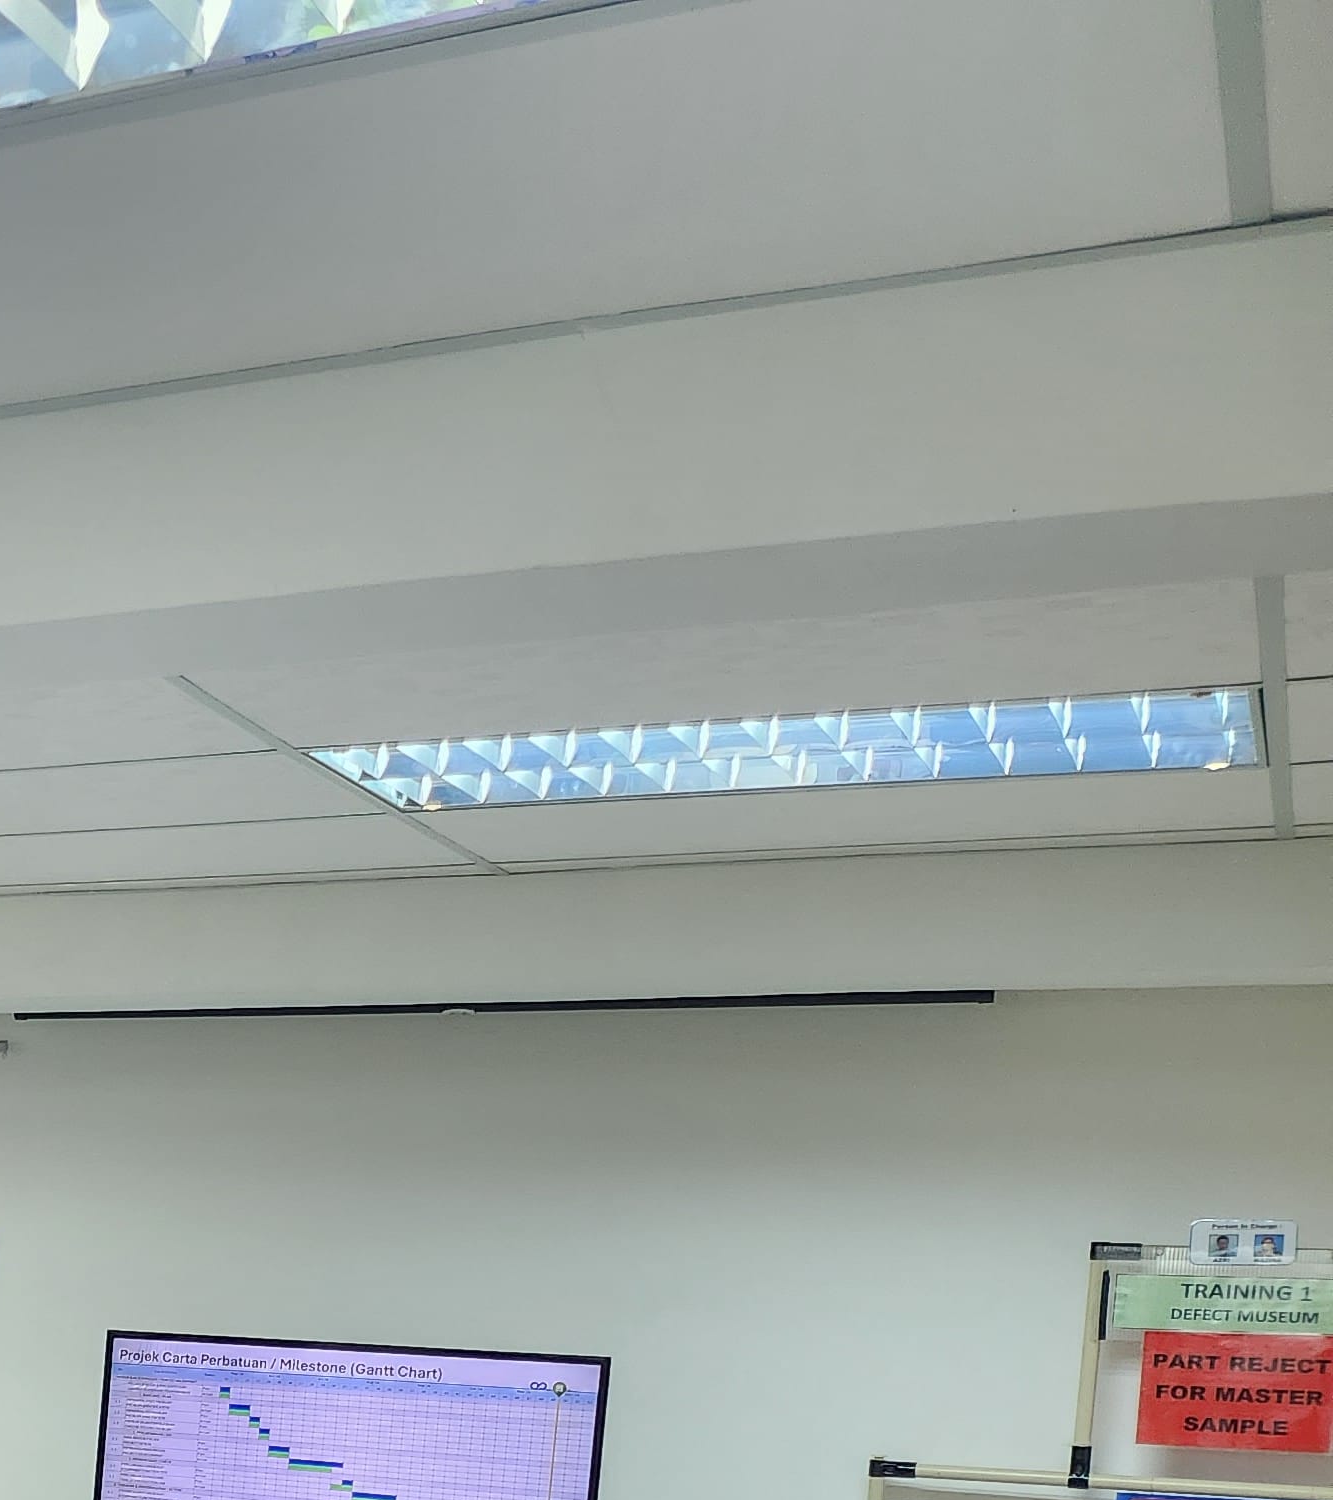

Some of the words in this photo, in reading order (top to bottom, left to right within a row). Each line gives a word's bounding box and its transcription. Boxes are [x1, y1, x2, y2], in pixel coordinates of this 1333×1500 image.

[1180, 1283, 1293, 1301] TRAINING
[1300, 1286, 1314, 1302] 1
[1170, 1308, 1233, 1322] DEFECT
[1237, 1310, 1320, 1324] MUSEUM
[119, 1349, 159, 1363] Projek
[162, 1351, 197, 1365] Carta
[200, 1354, 267, 1370] Perbatuan
[279, 1359, 347, 1374] Milestone
[350, 1363, 395, 1378] (Gantt
[397, 1366, 443, 1382] Chart)
[1152, 1352, 1221, 1372] PART
[1229, 1354, 1332, 1376] REJECT
[1155, 1384, 1206, 1402] FOR
[1215, 1386, 1324, 1406] MASTER
[1183, 1416, 1289, 1436] SAMPLE
